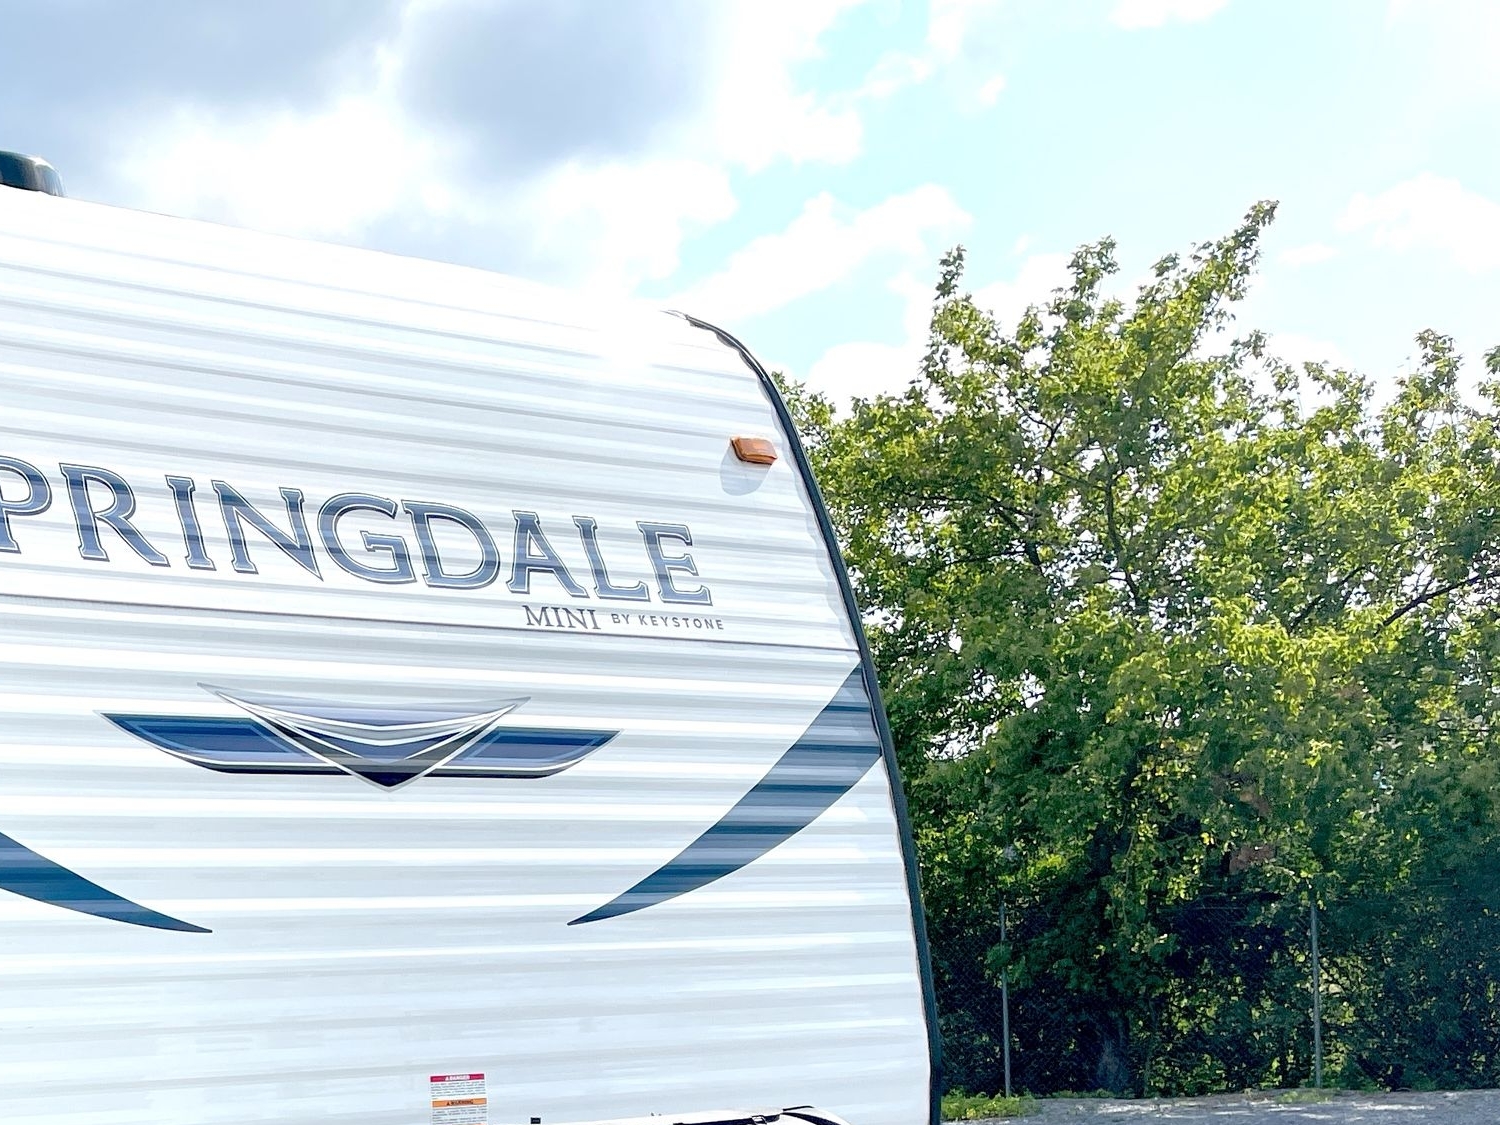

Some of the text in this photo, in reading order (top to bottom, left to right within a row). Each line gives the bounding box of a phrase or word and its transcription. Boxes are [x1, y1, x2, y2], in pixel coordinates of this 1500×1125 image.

[522, 605, 724, 630] MINI BY KEYSTONE
